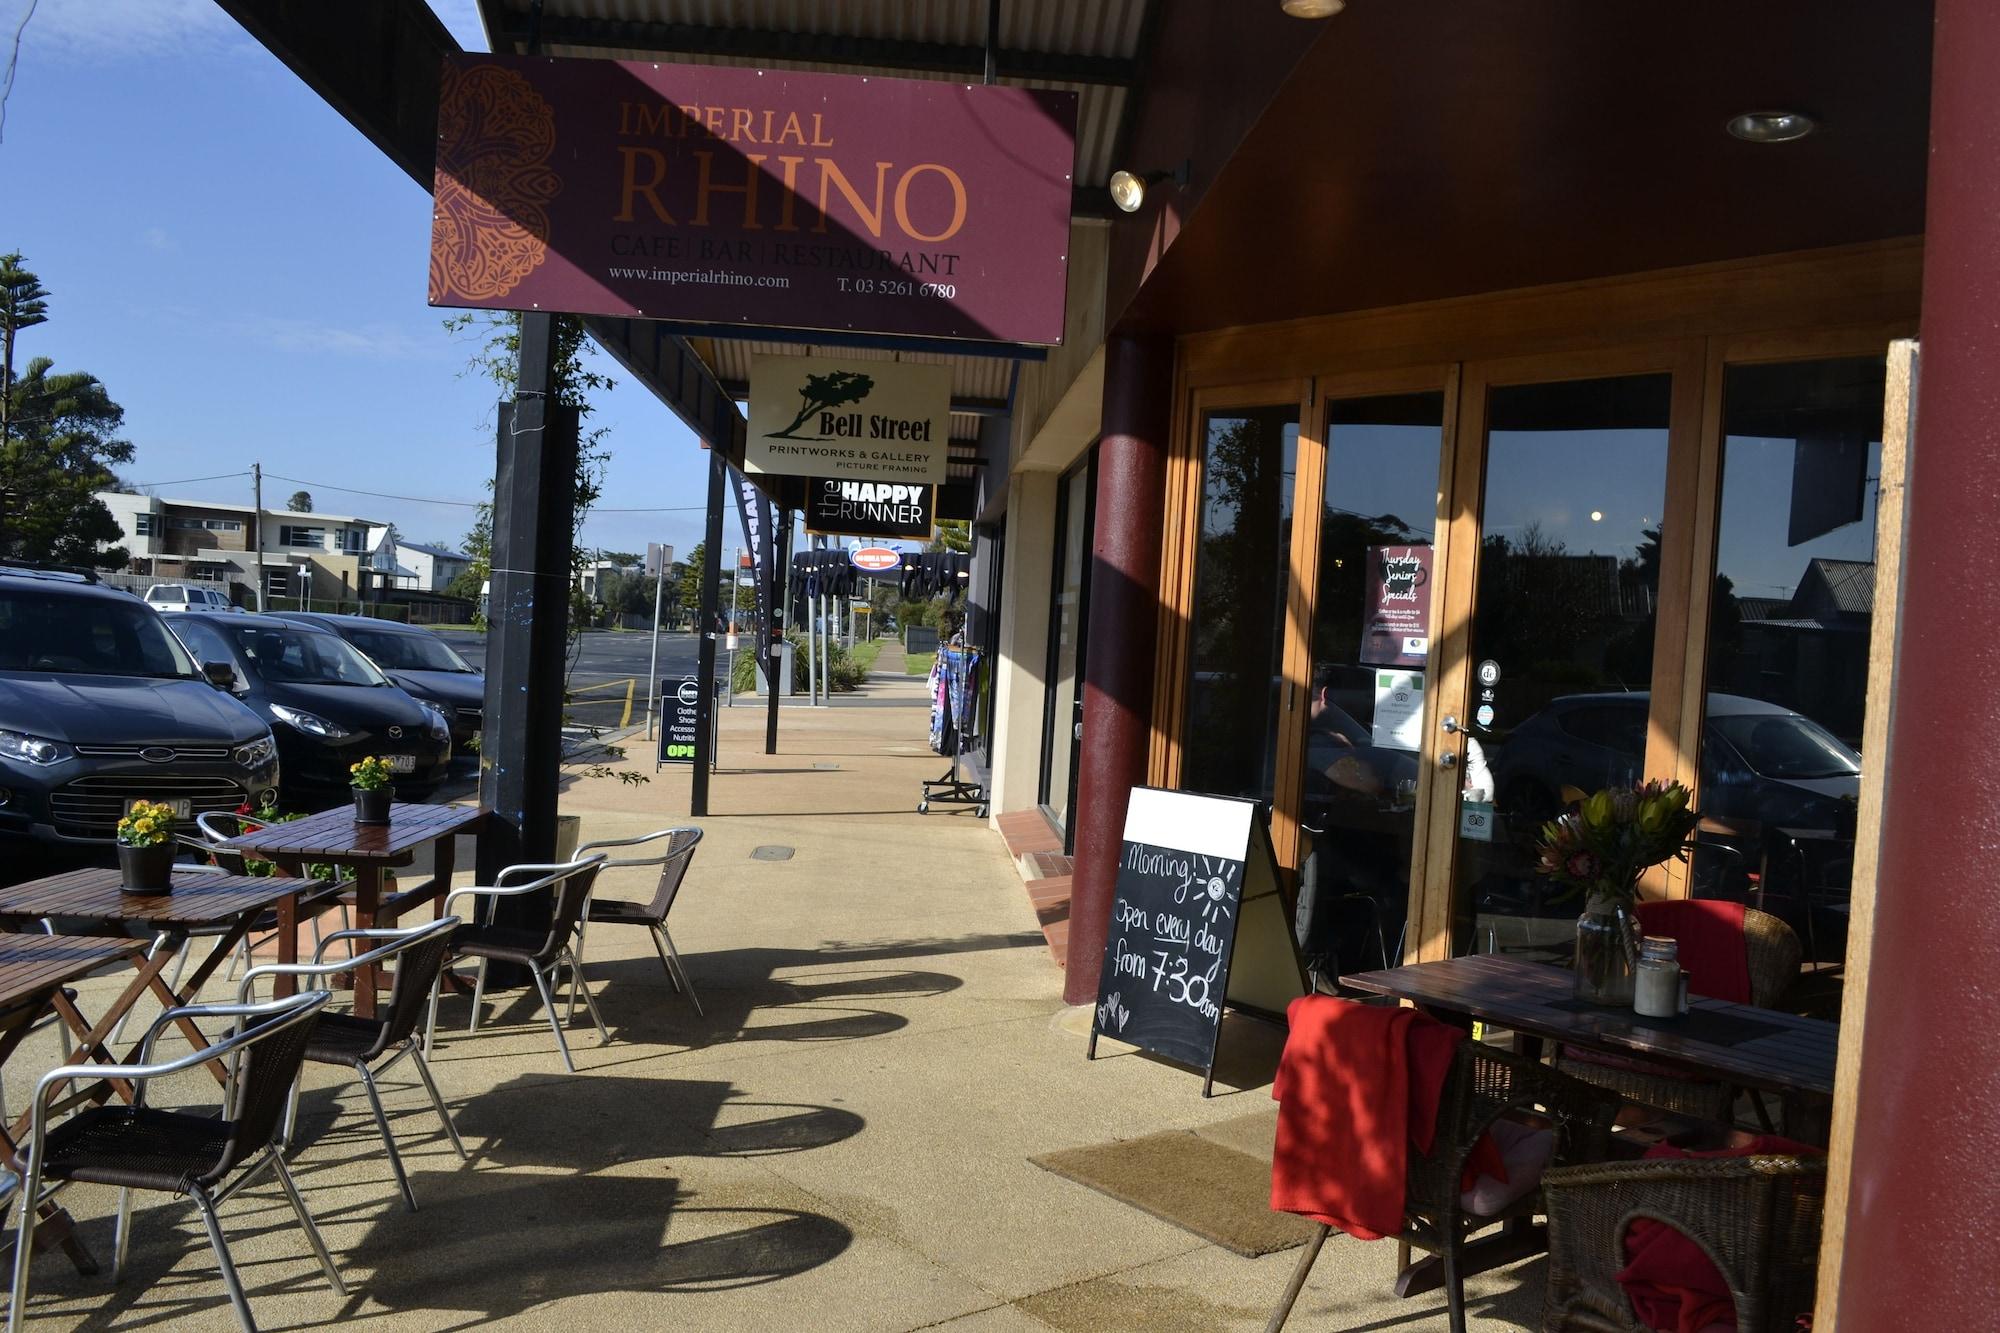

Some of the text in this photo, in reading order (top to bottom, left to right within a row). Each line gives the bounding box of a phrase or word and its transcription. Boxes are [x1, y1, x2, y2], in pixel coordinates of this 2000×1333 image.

[617, 100, 835, 147] IMPERIAL
[613, 143, 969, 243] RHINO
[610, 233, 960, 276] CAFE BAR RESTAURANT
[608, 264, 956, 299] www.imperialrhino.com T. 03 5261 6780
[819, 411, 932, 442] Bell Street
[768, 444, 931, 463] PRINTWORKS & GALLERY
[836, 461, 928, 474] PICTURE FRAMING
[817, 480, 841, 518] the
[841, 481, 924, 506] HAPPY
[840, 501, 924, 525] RUNNER
[1380, 548, 1421, 572] Thursday
[1385, 564, 1418, 584] Seniors
[1381, 584, 1419, 606] Specials
[1128, 844, 1197, 904] Morning!
[1115, 899, 1224, 983] Open every day
[1114, 937, 1146, 980] from
